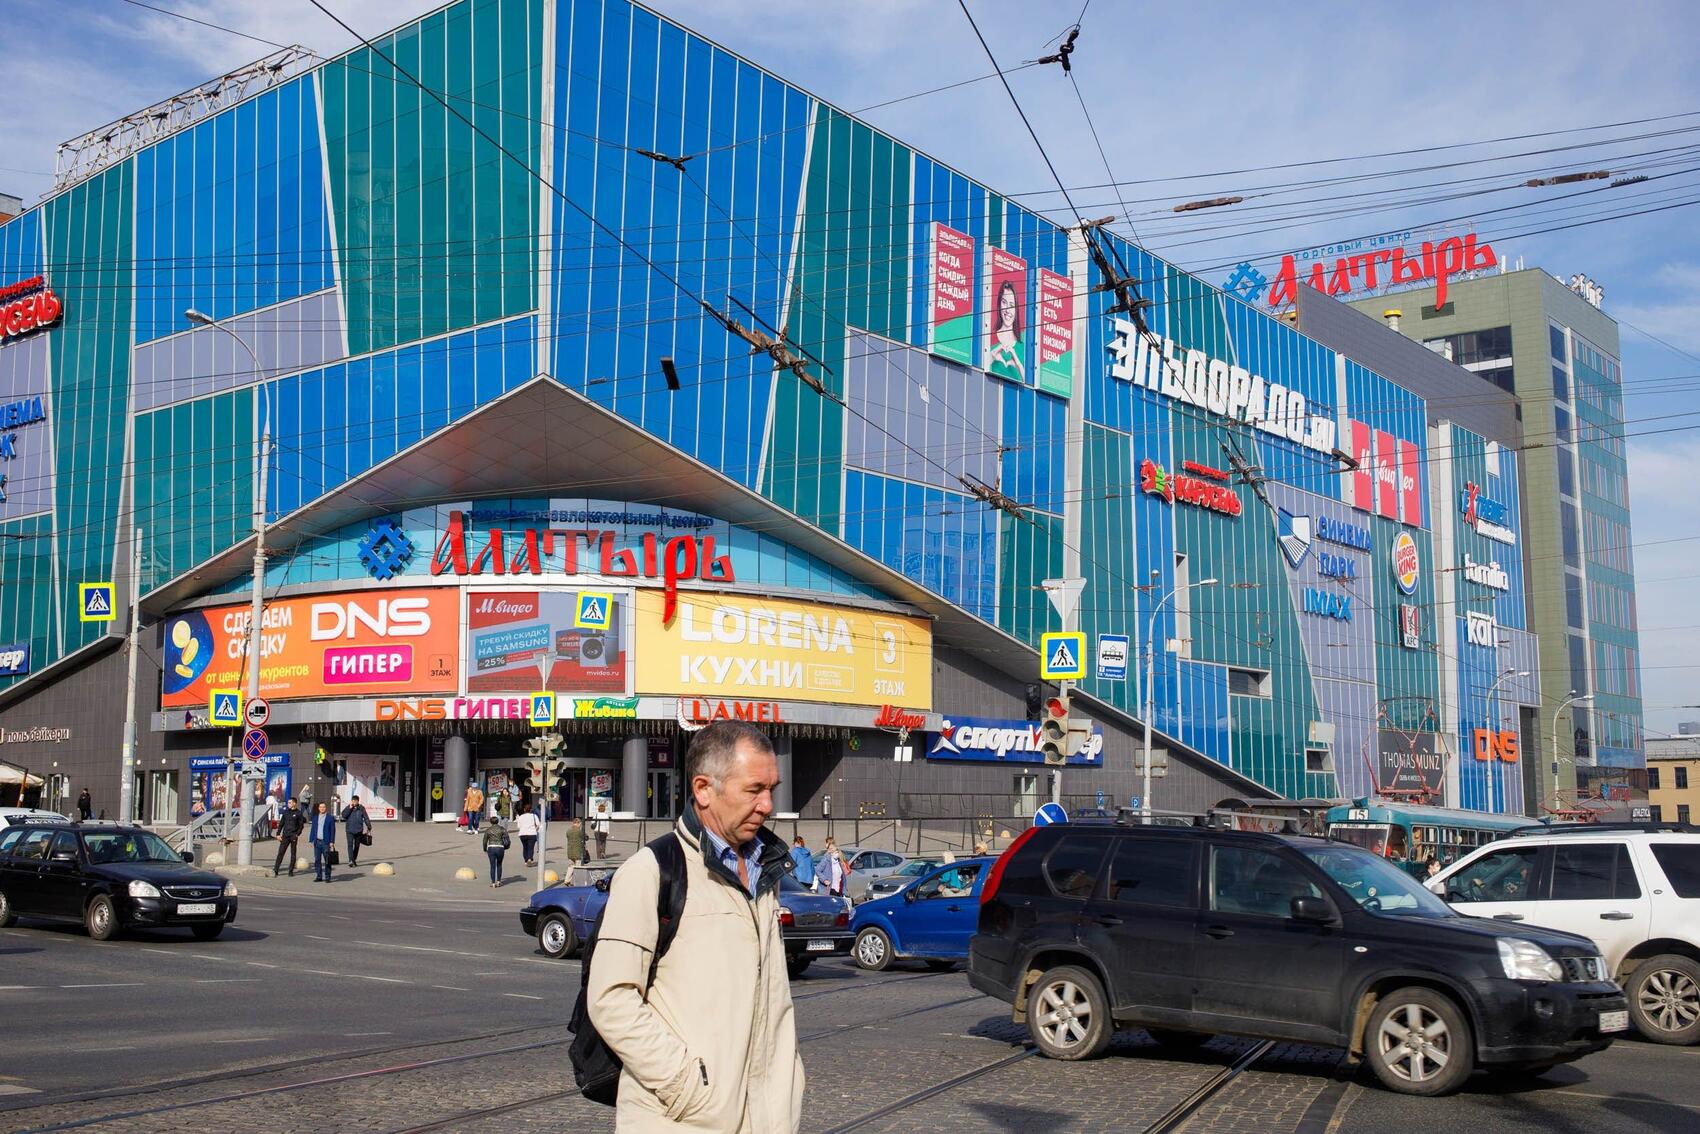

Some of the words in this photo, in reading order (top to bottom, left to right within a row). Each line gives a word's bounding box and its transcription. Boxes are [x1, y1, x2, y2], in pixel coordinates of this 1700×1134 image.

[1294, 241, 1362, 260] торговый
[1369, 231, 1411, 249] центр
[938, 251, 960, 269] КОГДА
[938, 266, 966, 286] СКИДКИ
[938, 280, 969, 302] КАЖДЫЙ
[1043, 292, 1063, 309] КОГДА
[937, 296, 956, 312] ДЕНЬ
[1043, 306, 1058, 320] ЕСТЬ
[1043, 321, 1072, 340] ГАРАНТИЯ
[1043, 334, 1067, 352] НИЗКОЙ
[1042, 347, 1060, 364] ЦЕНЫ
[1316, 514, 1372, 551] СИНЕМА
[1397, 545, 1415, 559] BURGER
[430, 510, 736, 624] Алатырь
[1318, 551, 1355, 578] ПАРК
[1397, 556, 1417, 577] KING
[1304, 587, 1353, 621] IMAX
[223, 605, 293, 637] СДЕАЕМ
[310, 597, 431, 641] DNS
[680, 602, 854, 655] LORENA
[478, 646, 494, 656] НА
[495, 637, 549, 653] SAMSUNG
[480, 632, 512, 646] ТРЕБУЙ
[513, 628, 549, 640] СКИДКУ
[1406, 636, 1417, 647] KFC
[881, 630, 897, 665] 3
[330, 652, 403, 676] ГИПЕР
[437, 658, 443, 668] 1
[484, 656, 506, 668] 25%
[206, 672, 217, 685] от
[430, 668, 451, 677] ЭТАЖ
[680, 655, 803, 689] КУХНИ
[873, 678, 905, 697] ЭТАЖ
[375, 699, 447, 721] DNS
[575, 700, 637, 718] Живика
[692, 699, 785, 724] LAMEL
[1474, 728, 1519, 763] DNS
[1382, 751, 1416, 769] THOMAS
[1353, 809, 1366, 820] 15
